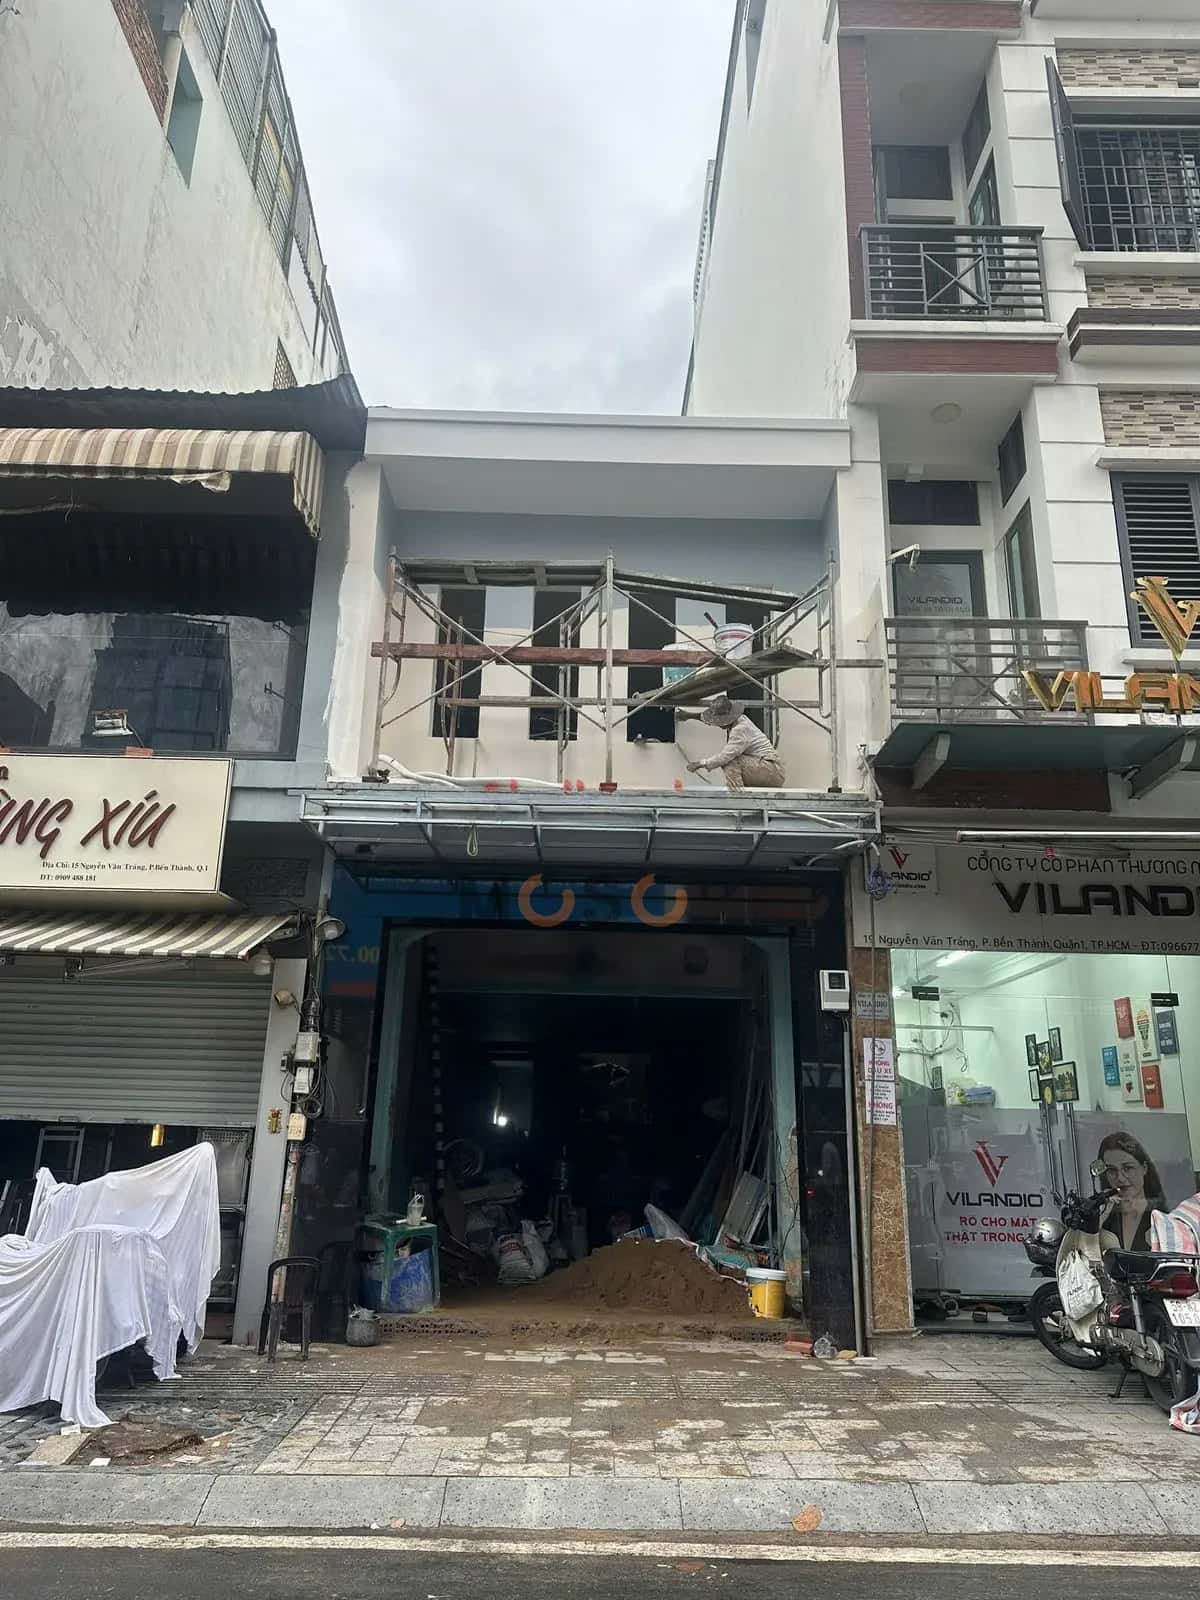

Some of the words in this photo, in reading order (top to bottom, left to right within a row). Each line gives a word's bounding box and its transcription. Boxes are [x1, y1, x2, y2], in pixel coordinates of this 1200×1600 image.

[80, 789, 176, 850] XÍU
[1014, 857, 1037, 871] TY
[879, 933, 919, 946] Nguyễn
[946, 1192, 1043, 1207] VILANDIO
[981, 1216, 1007, 1227] CHO
